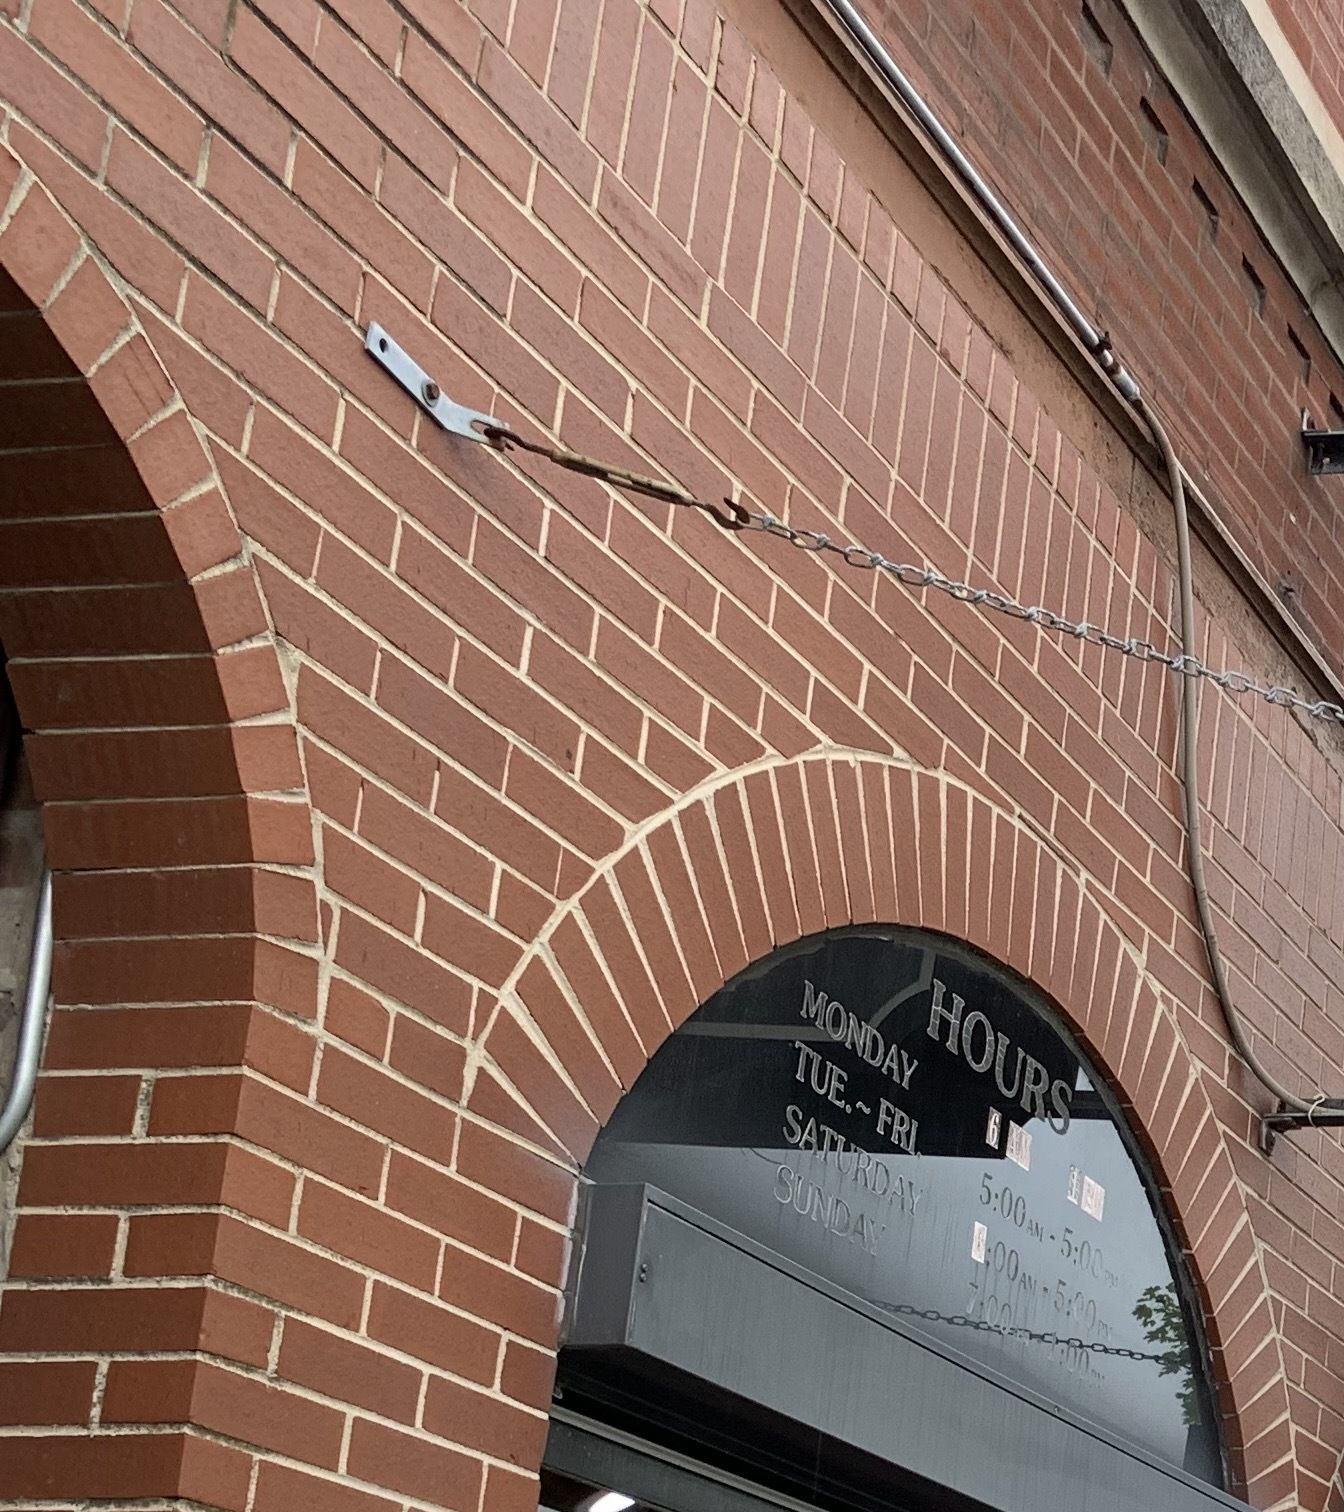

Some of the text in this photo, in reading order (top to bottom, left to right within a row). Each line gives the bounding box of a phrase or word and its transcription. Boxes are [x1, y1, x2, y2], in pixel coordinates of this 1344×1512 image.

[800, 980, 918, 1090] MONDAY
[926, 978, 1073, 1135] HOURS
[774, 1164, 887, 1258] SUNDAY
[782, 1105, 923, 1216] SATURDAY
